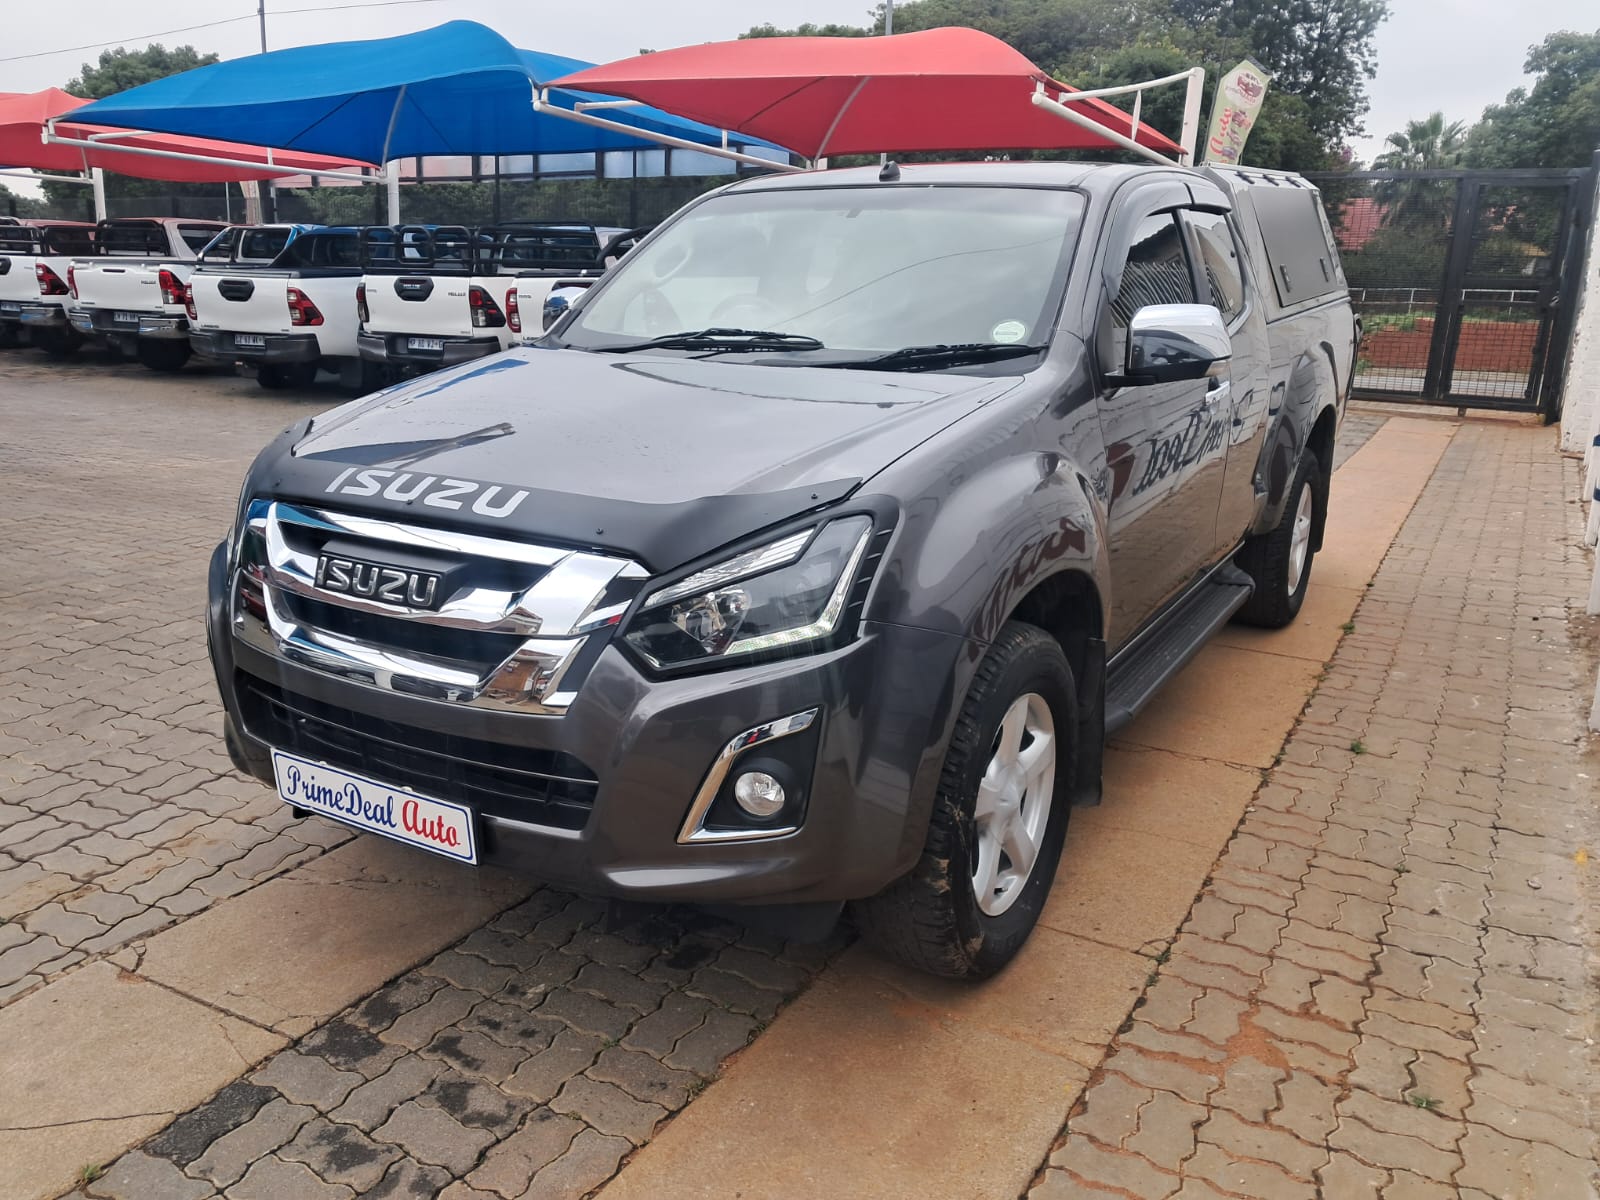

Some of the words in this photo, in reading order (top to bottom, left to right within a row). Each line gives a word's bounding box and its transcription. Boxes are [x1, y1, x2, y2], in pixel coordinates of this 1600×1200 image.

[324, 467, 530, 518] ISUZU
[316, 555, 438, 607] ISUZU
[287, 765, 397, 828] PrimeDeal
[402, 799, 461, 848] Auto
